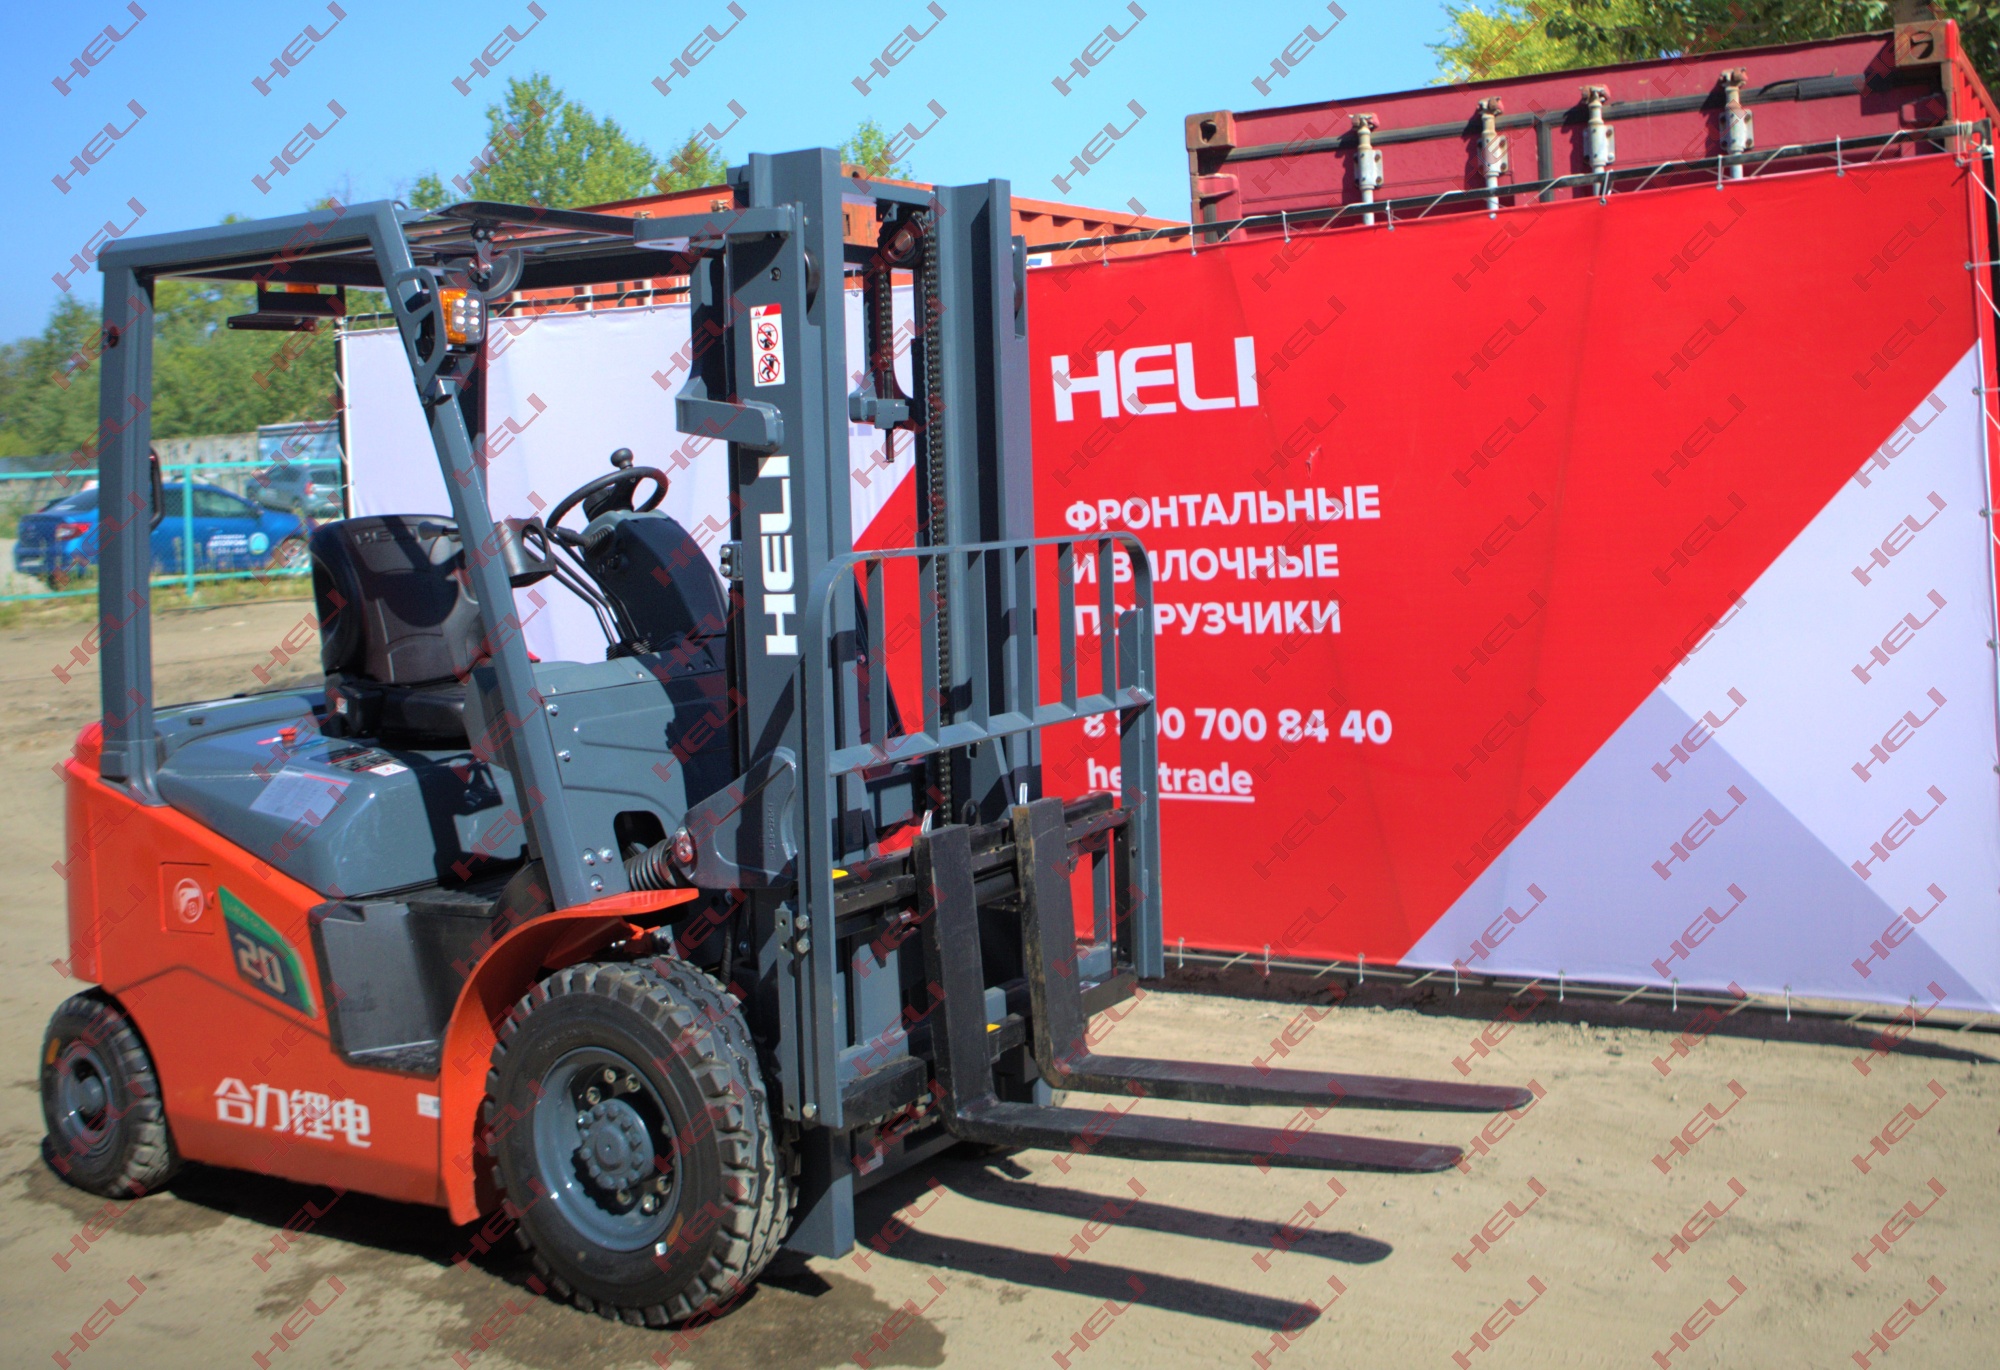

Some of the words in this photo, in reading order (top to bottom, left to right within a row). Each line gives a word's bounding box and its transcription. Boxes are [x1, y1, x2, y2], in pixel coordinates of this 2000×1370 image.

[1051, 336, 1259, 422] HELI
[1065, 485, 1381, 531] ФРОНТАЛЬНЫЕ
[758, 456, 799, 655] HELI
[1195, 707, 1267, 741] 700
[1278, 709, 1329, 743] 84
[1340, 710, 1393, 744] 40
[234, 933, 286, 994] 20
[213, 1077, 372, 1148] 合力锂电
